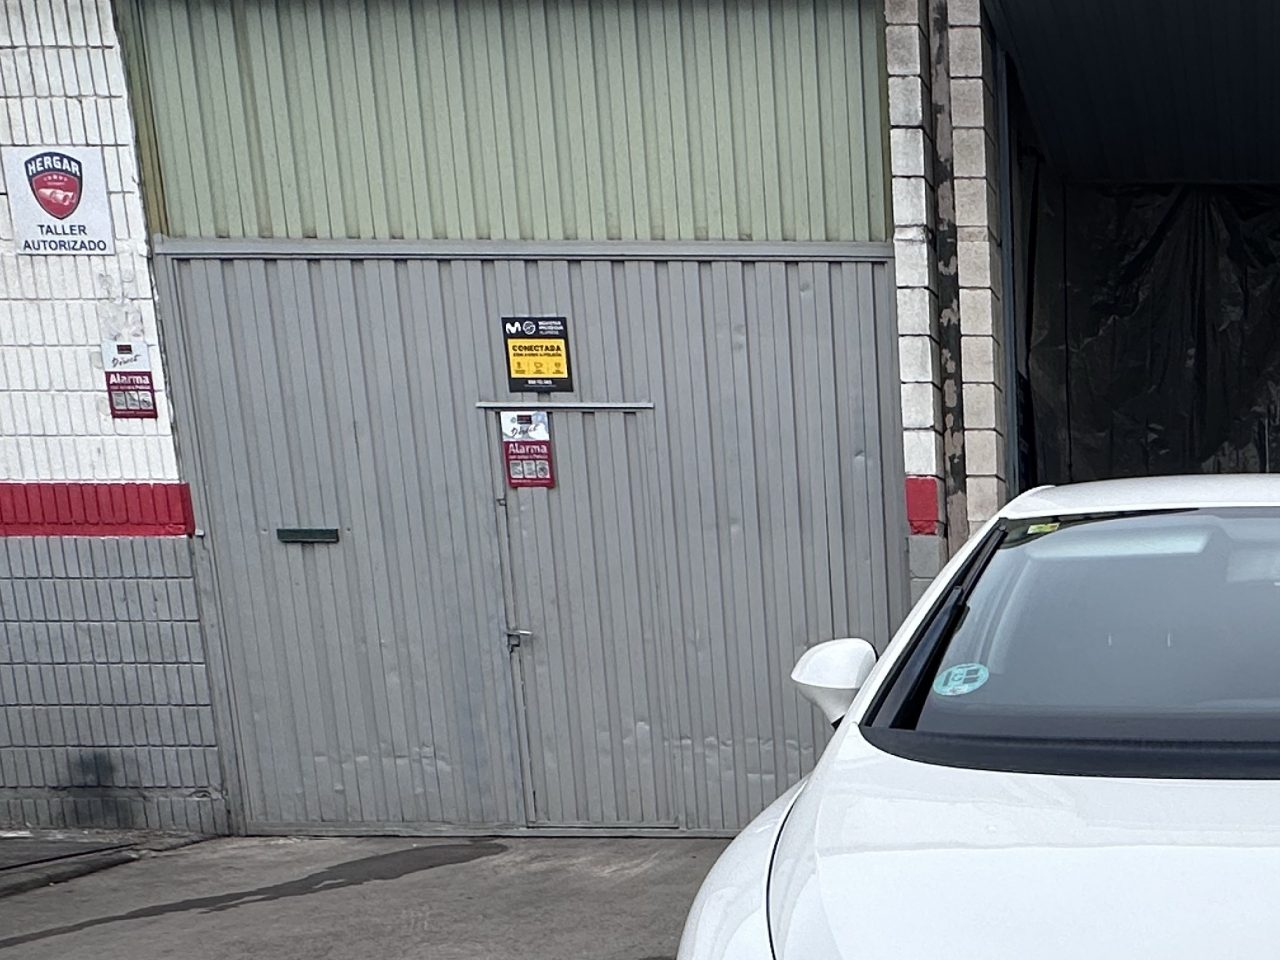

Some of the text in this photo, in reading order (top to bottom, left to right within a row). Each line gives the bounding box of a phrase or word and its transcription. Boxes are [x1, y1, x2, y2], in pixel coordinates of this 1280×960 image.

[27, 156, 80, 176] HERGAR
[37, 224, 88, 236] TALLER
[23, 239, 107, 251] AUTORIZADO
[512, 344, 562, 352] CONECTADA
[109, 373, 150, 385] Alarma
[508, 443, 548, 454] Alarma
